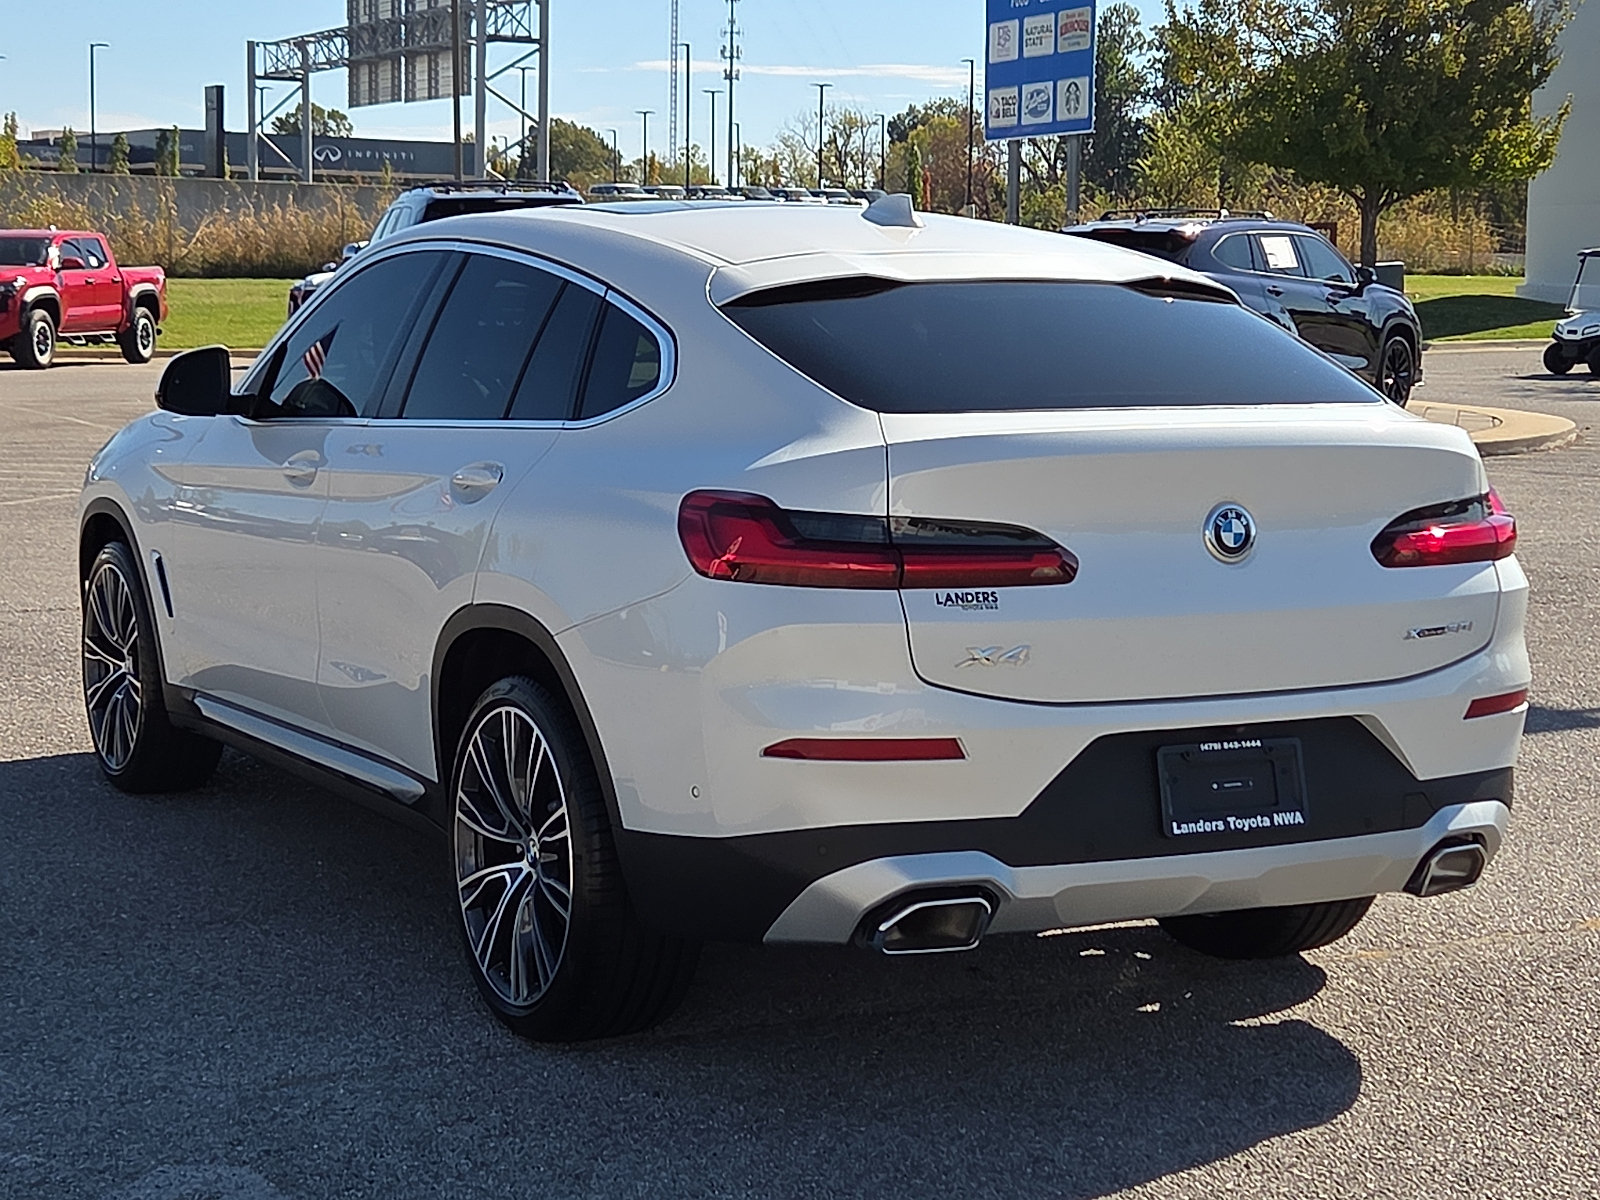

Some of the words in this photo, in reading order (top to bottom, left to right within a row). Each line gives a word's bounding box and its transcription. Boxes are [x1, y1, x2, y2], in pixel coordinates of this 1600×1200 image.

[1025, 24, 1053, 36] NATURAL
[1025, 36, 1043, 48] STATE
[1001, 95, 1017, 107] TACO
[1002, 107, 1017, 118] BELL
[348, 150, 415, 161] INFINITI
[935, 591, 998, 606] LANDERS
[954, 644, 1031, 669] X4
[1171, 820, 1225, 835] Landers
[1227, 815, 1271, 832] Toyota
[1273, 811, 1304, 826] NWA
